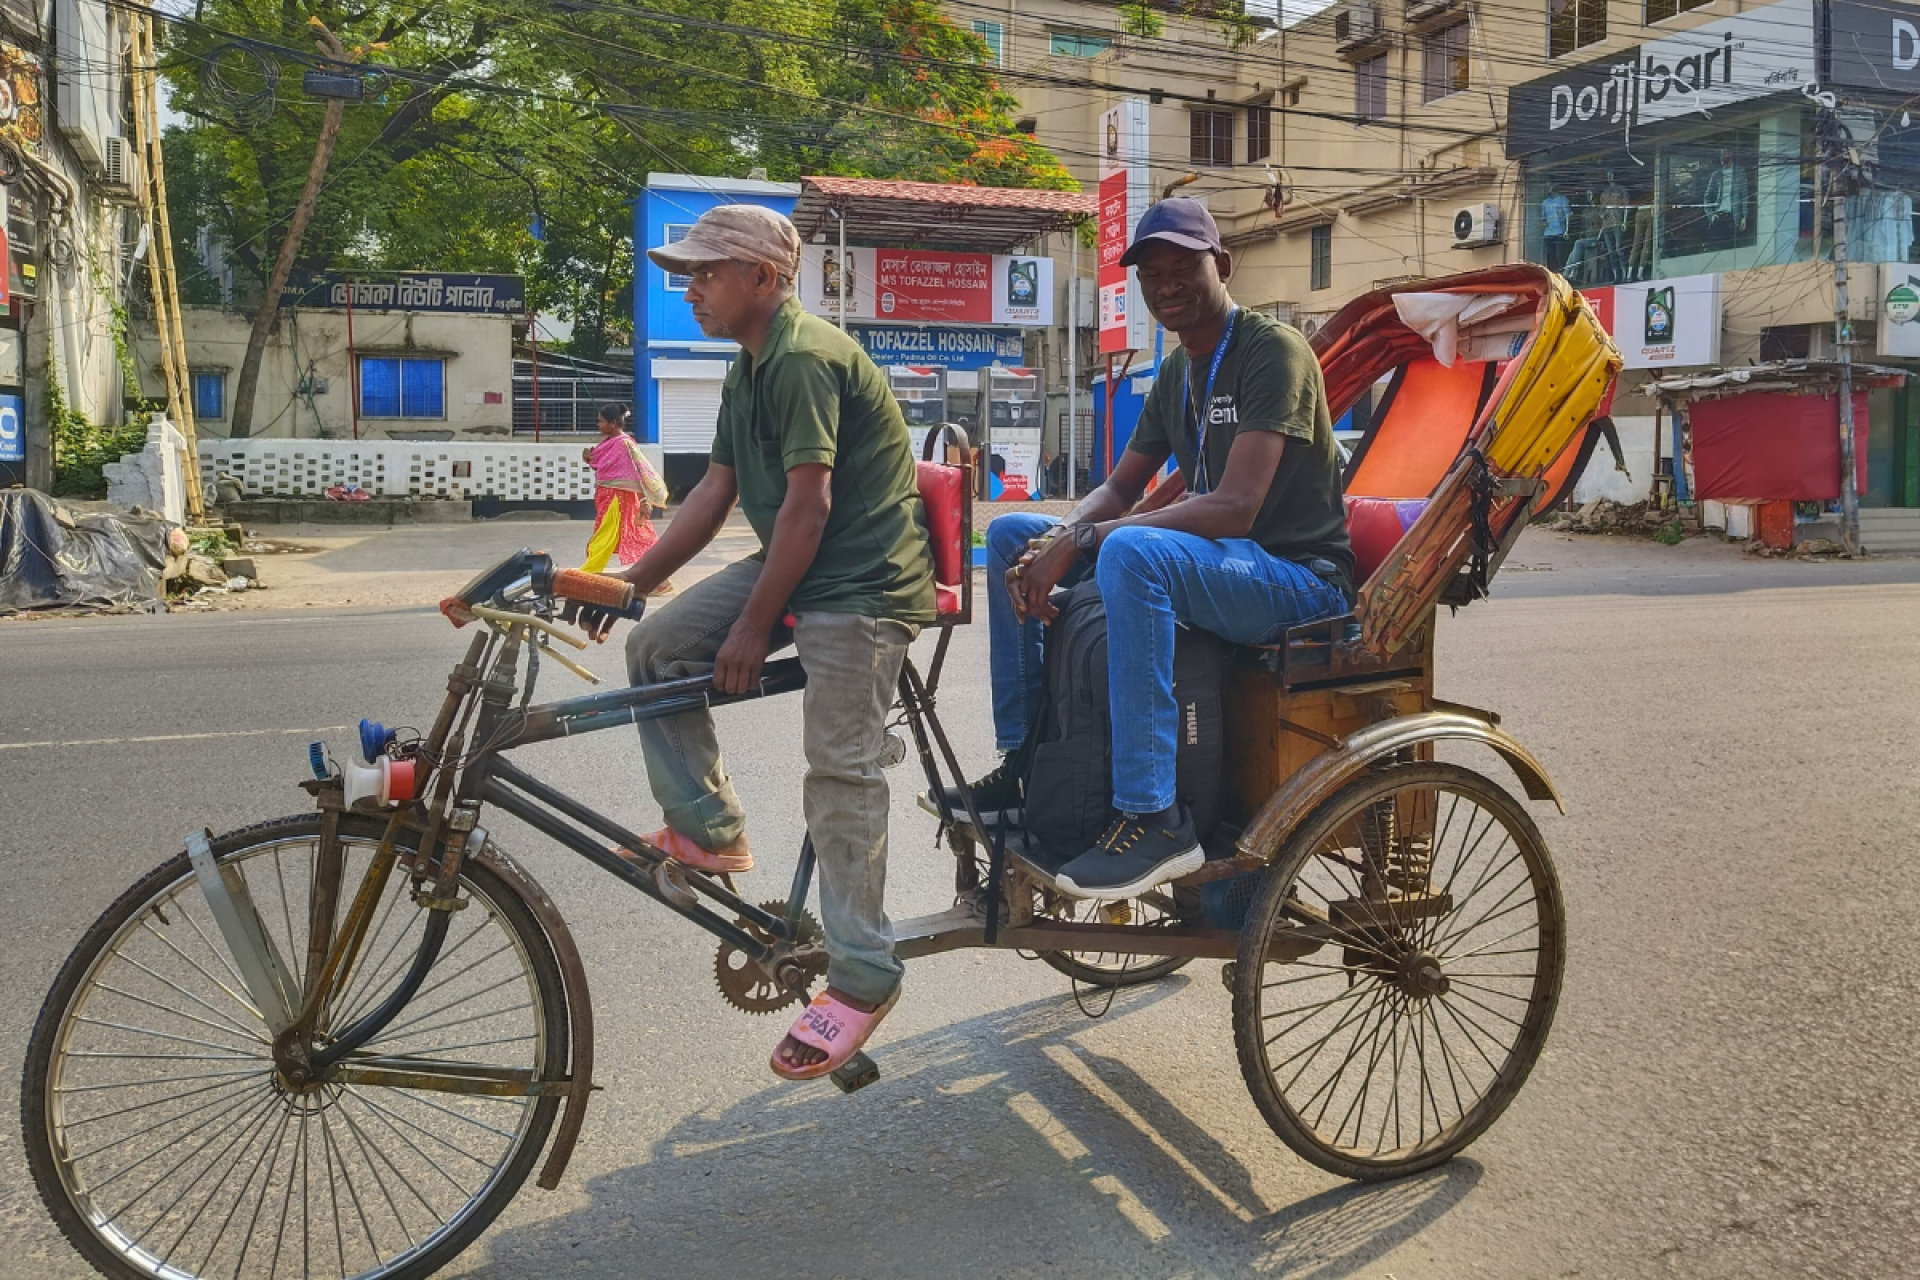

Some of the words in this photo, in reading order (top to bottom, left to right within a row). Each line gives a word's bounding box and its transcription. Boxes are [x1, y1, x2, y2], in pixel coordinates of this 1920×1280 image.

[446, 277, 494, 312] পার্লার
[900, 276, 945, 288] TOFAZZEL
[947, 278, 987, 289] HOSSAIN
[869, 331, 934, 351] TOFAZZEL
[939, 333, 994, 353] HOSSAIN
[1187, 702, 1197, 744] THULE
